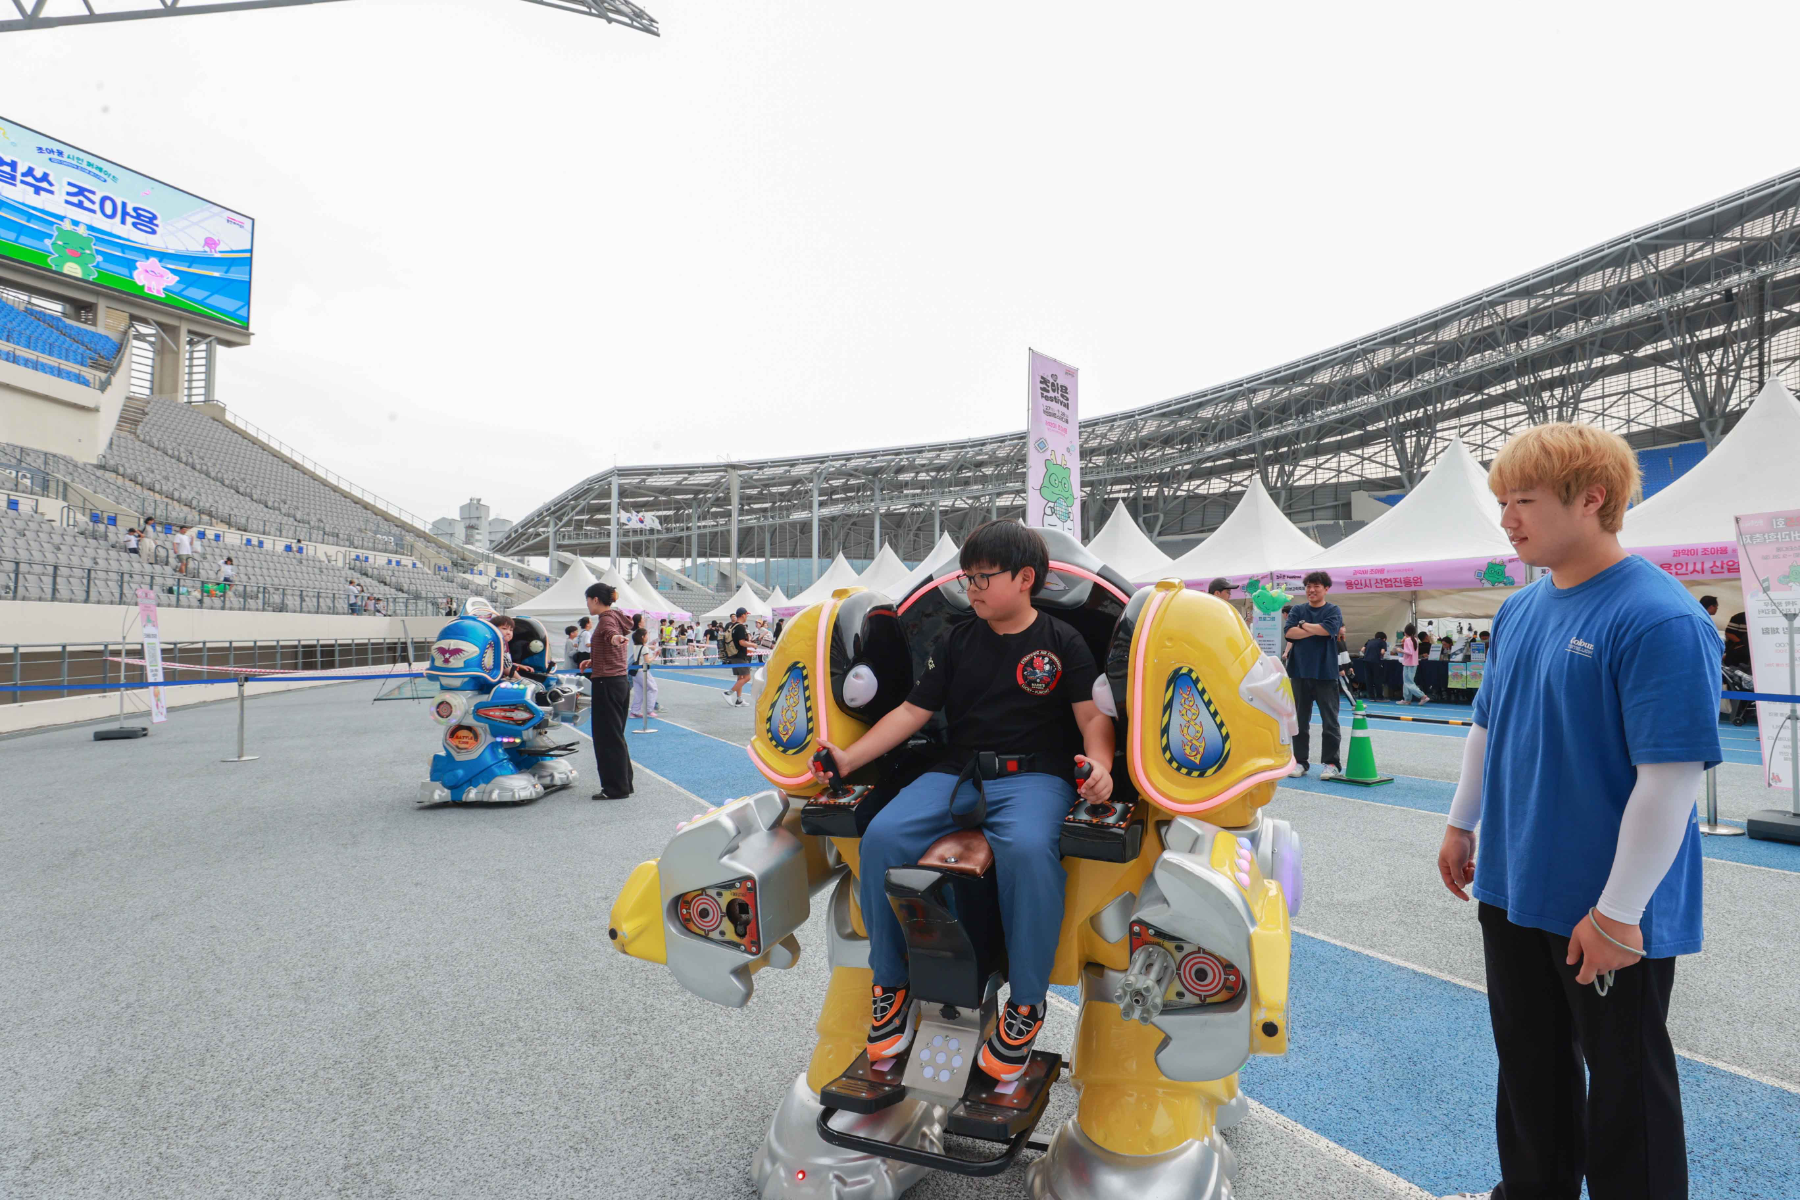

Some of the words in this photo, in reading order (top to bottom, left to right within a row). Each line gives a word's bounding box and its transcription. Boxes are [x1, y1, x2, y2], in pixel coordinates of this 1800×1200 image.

[64, 181, 160, 236] 조아용
[1039, 374, 1069, 402] 조아용
[1040, 392, 1070, 411] Festival
[1672, 548, 1699, 558] 과학이
[1701, 546, 1728, 556] 조아용
[1659, 561, 1705, 576] 용인시
[1345, 578, 1373, 590] 용인시
[1374, 576, 1424, 589] 산업진흥원
